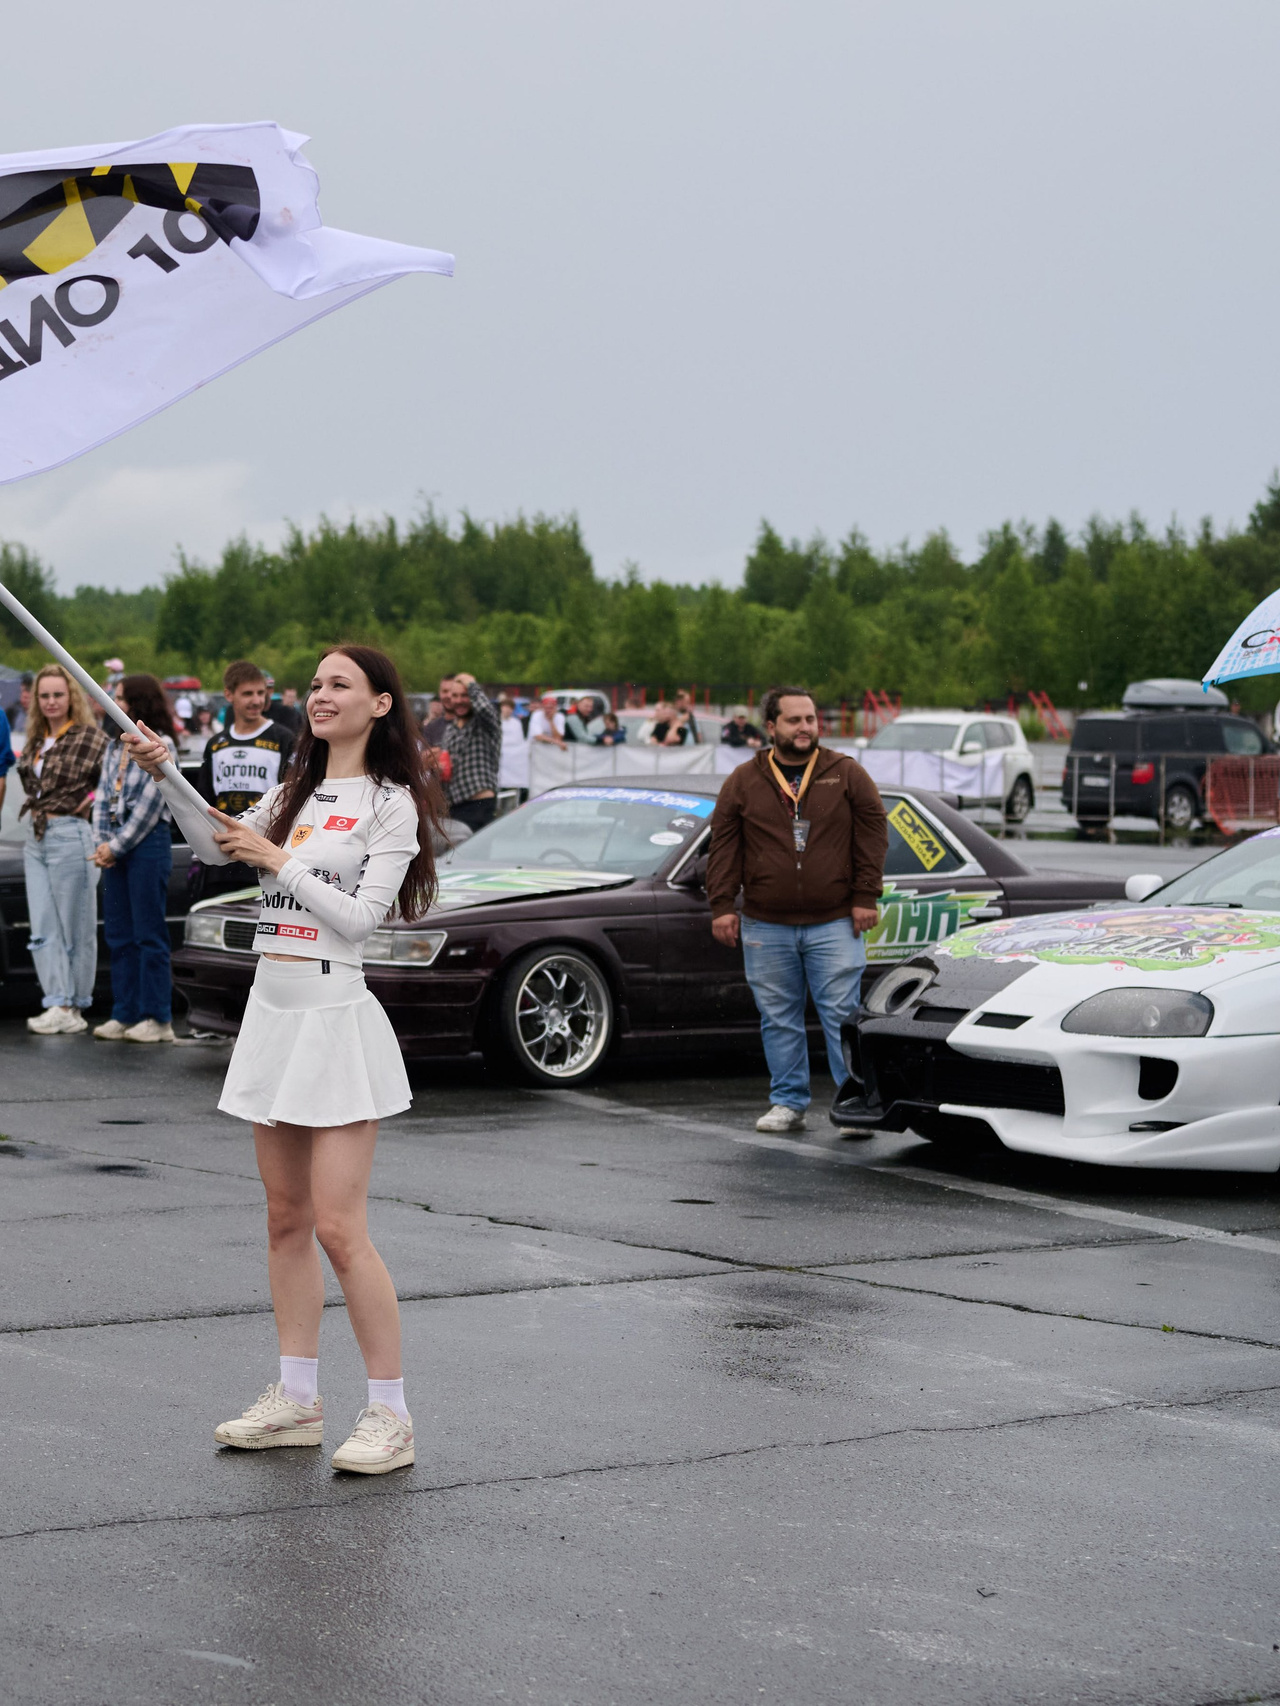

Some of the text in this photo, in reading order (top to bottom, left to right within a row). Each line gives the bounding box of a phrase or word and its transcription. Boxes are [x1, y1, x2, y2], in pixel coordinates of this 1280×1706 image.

[216, 761, 267, 784] Corona
[897, 807, 942, 860] DFM
[278, 926, 317, 941] GOLD
